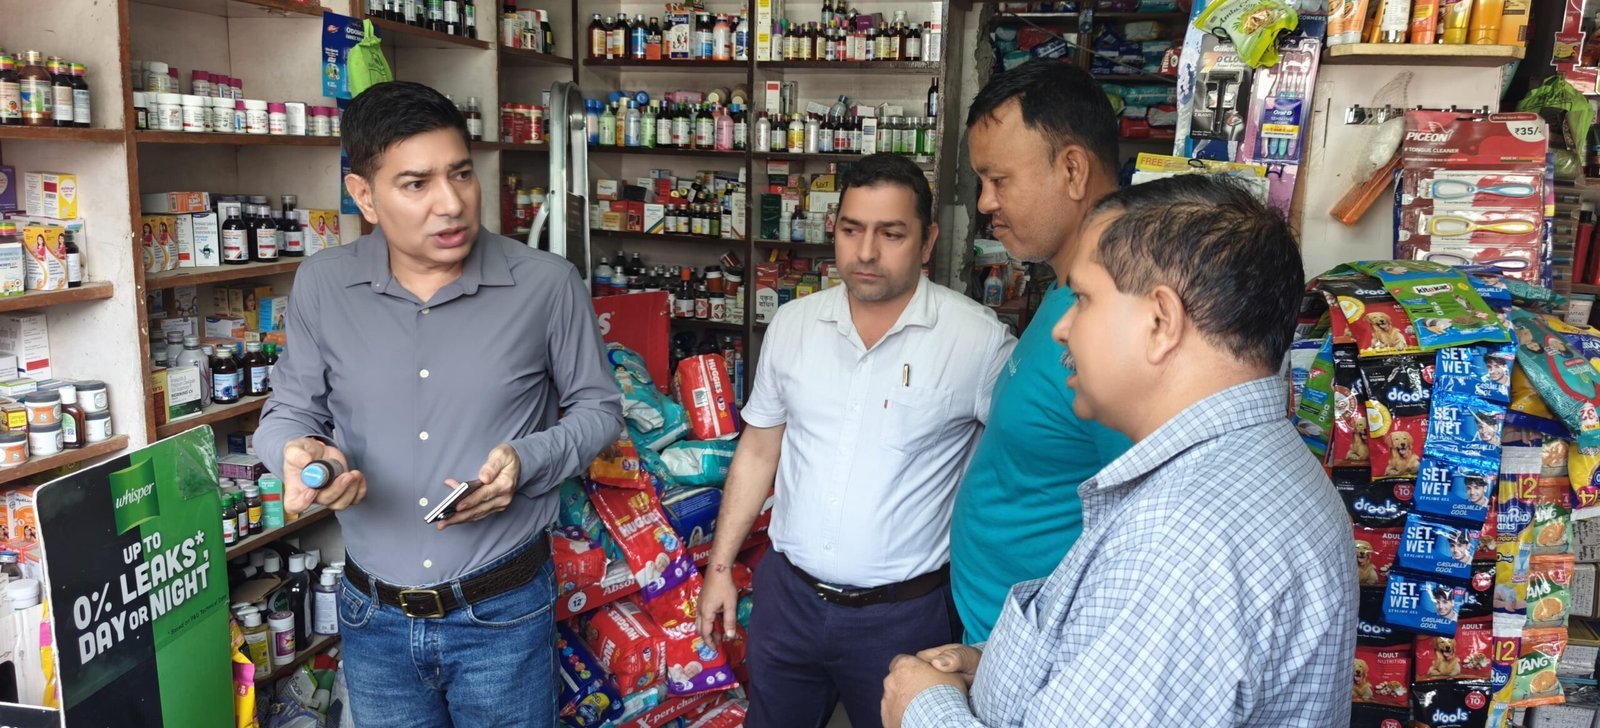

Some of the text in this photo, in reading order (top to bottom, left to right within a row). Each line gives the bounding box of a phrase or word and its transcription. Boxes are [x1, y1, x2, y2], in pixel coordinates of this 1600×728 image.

[1406, 132, 1449, 142] PIGEON
[1140, 158, 1162, 166] FREE
[1441, 348, 1467, 361] SET
[1442, 361, 1471, 374] WET
[1388, 388, 1430, 402] drools
[1434, 407, 1458, 420] SET
[1434, 421, 1461, 435] WET
[1422, 467, 1449, 482] SET
[116, 482, 154, 509] whisper
[1422, 482, 1451, 495] WET
[1354, 498, 1397, 514] drools
[1407, 526, 1433, 540] SET
[123, 531, 161, 565] UP TO
[1406, 541, 1434, 553] WET
[1391, 582, 1417, 596] SET
[73, 582, 113, 630] 0%
[572, 598, 582, 607] 12
[1390, 595, 1419, 609] WET
[78, 561, 210, 664] DAY OR NIGHT
[608, 610, 640, 640] HUGGIES
[1496, 641, 1515, 661] 12
[1518, 656, 1548, 674] TANG
[1433, 708, 1468, 723] drools
